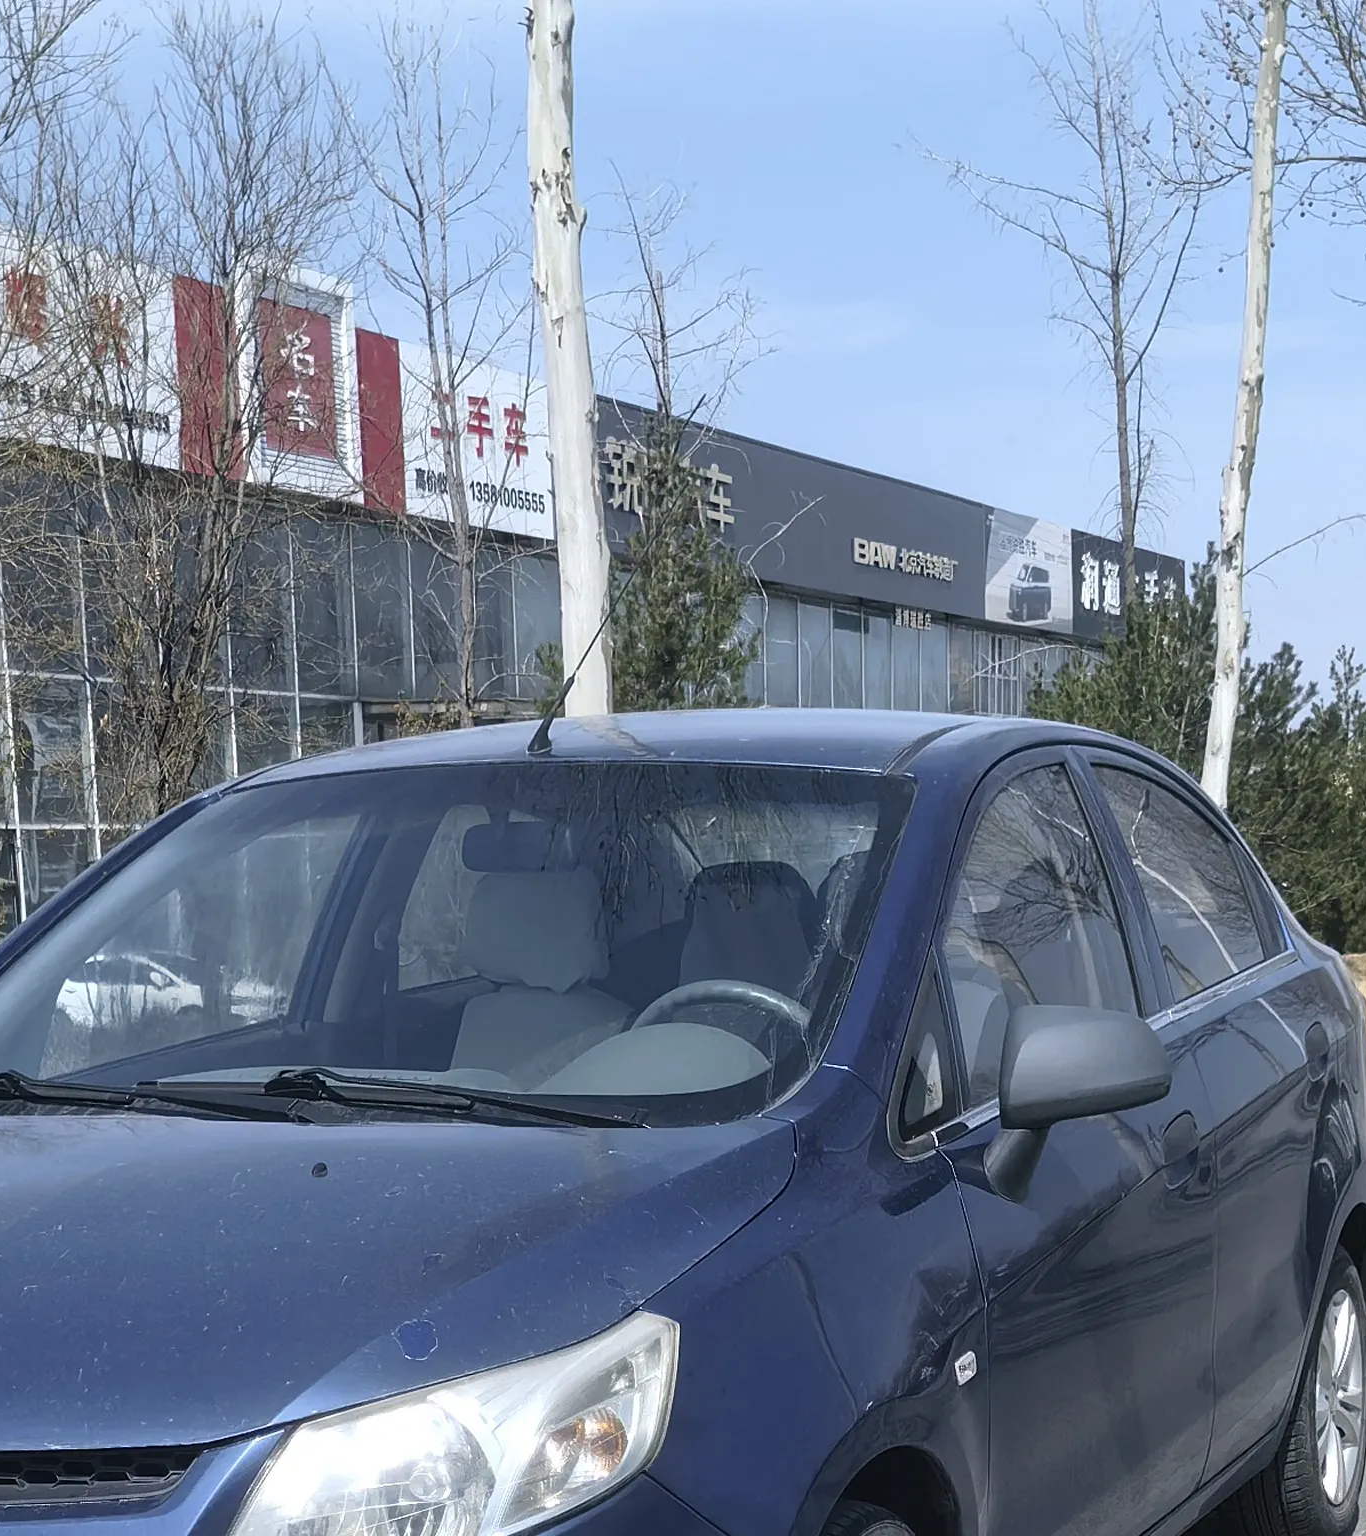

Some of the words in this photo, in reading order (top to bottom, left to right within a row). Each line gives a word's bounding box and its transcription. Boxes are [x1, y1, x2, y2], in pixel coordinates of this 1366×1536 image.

[430, 388, 529, 468] 二手车
[854, 537, 897, 570] BAW
